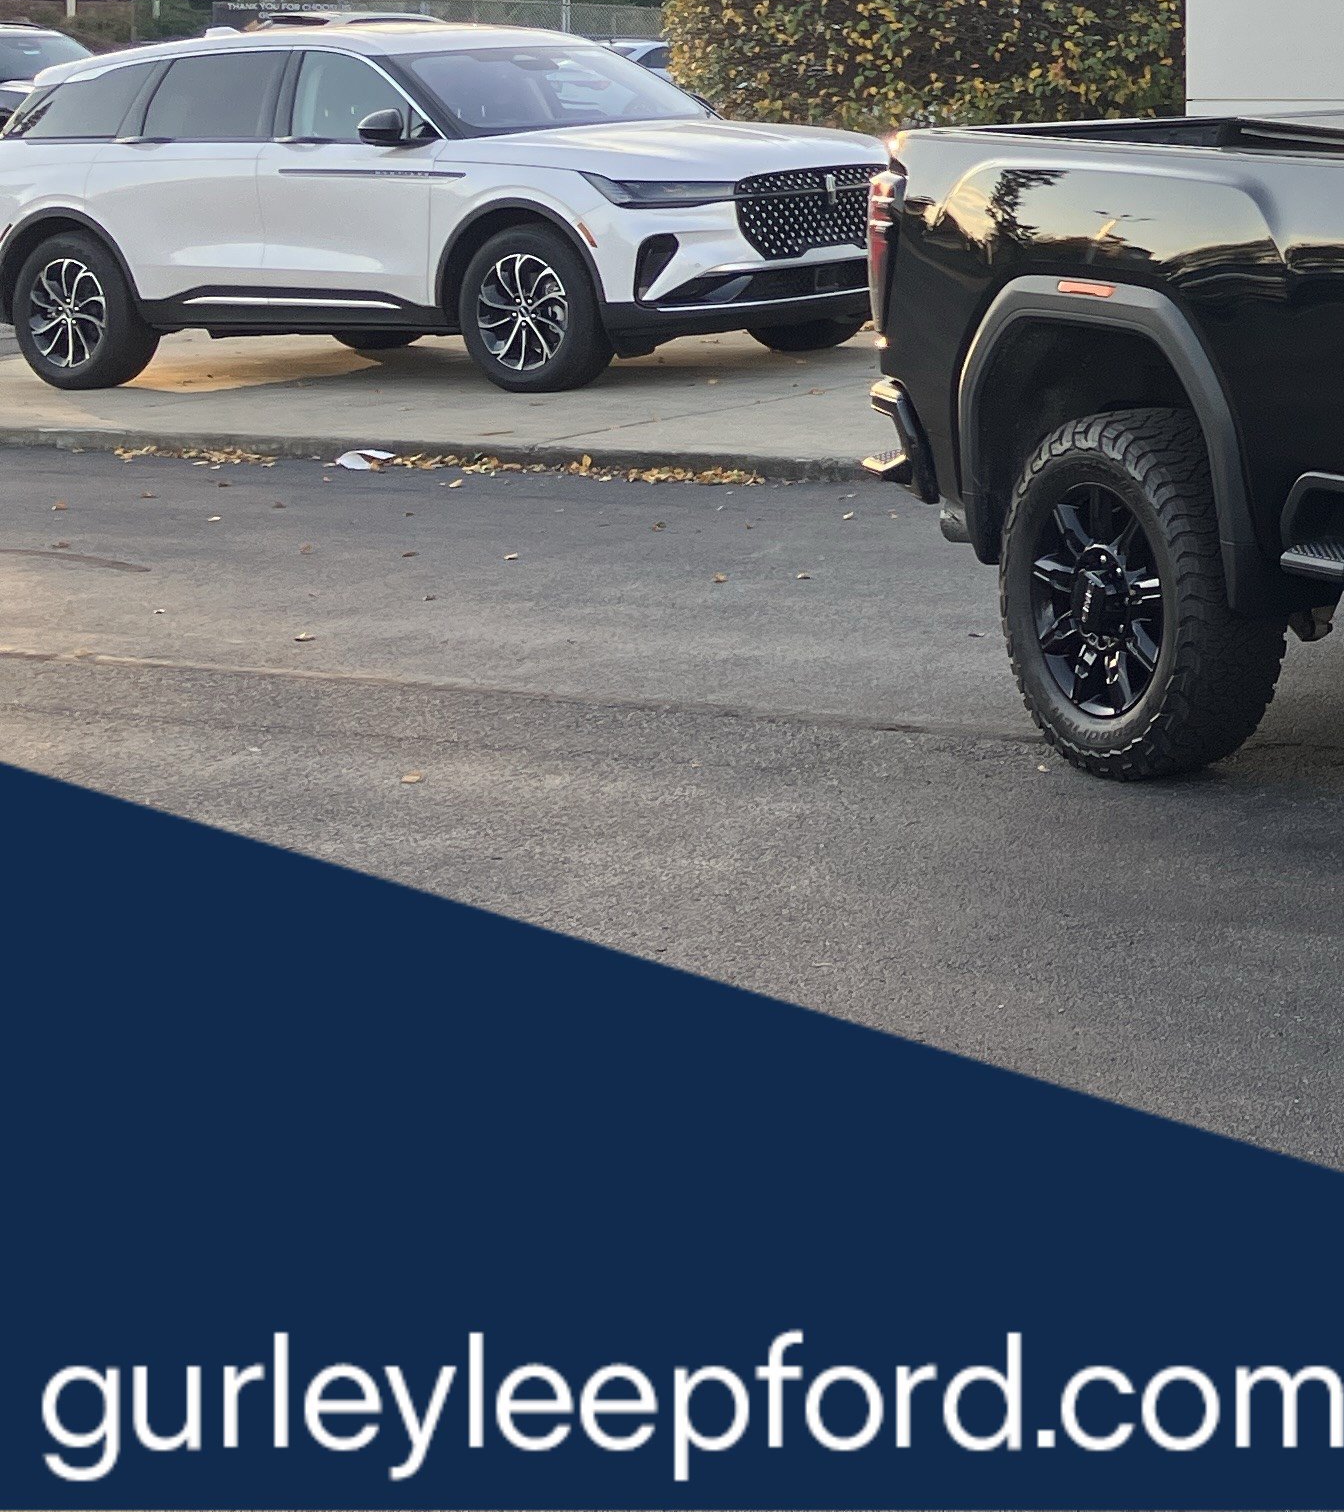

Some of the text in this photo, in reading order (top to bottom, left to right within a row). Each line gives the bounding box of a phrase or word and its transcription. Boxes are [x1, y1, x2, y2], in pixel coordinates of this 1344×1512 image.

[227, 2, 258, 11] THANK
[260, 2, 279, 11] YOU
[281, 2, 301, 11] FOR
